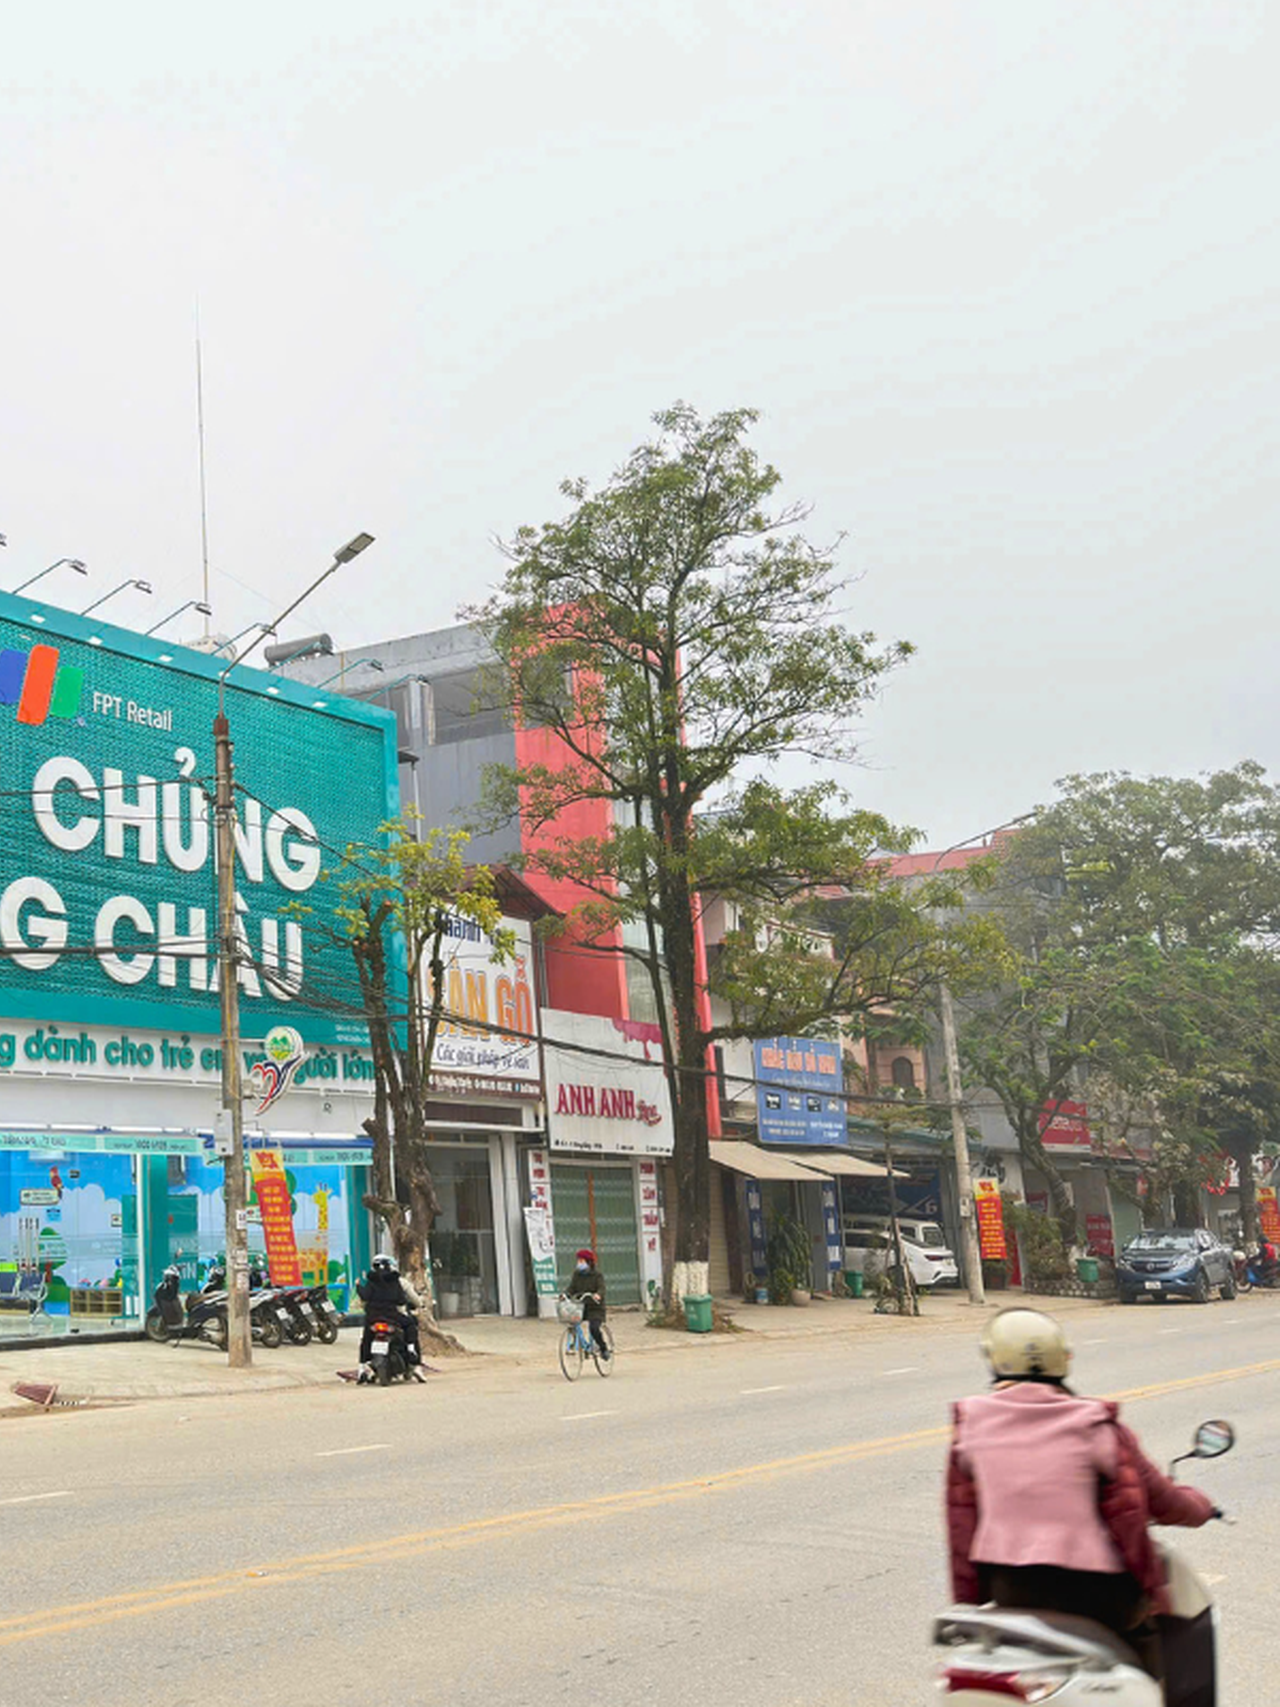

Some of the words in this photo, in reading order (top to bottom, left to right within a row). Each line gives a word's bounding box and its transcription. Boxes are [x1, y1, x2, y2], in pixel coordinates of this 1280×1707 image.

[93, 691, 123, 719] FPT
[126, 701, 173, 732] Retail
[31, 746, 322, 893] CHỦNG
[93, 890, 304, 1002] CHÂU
[25, 1026, 97, 1063] dành
[104, 1035, 154, 1067] cho
[161, 1035, 195, 1070] trẻ
[293, 1046, 339, 1085] gười
[555, 1083, 596, 1117] ANH
[599, 1087, 636, 1119] ANH
